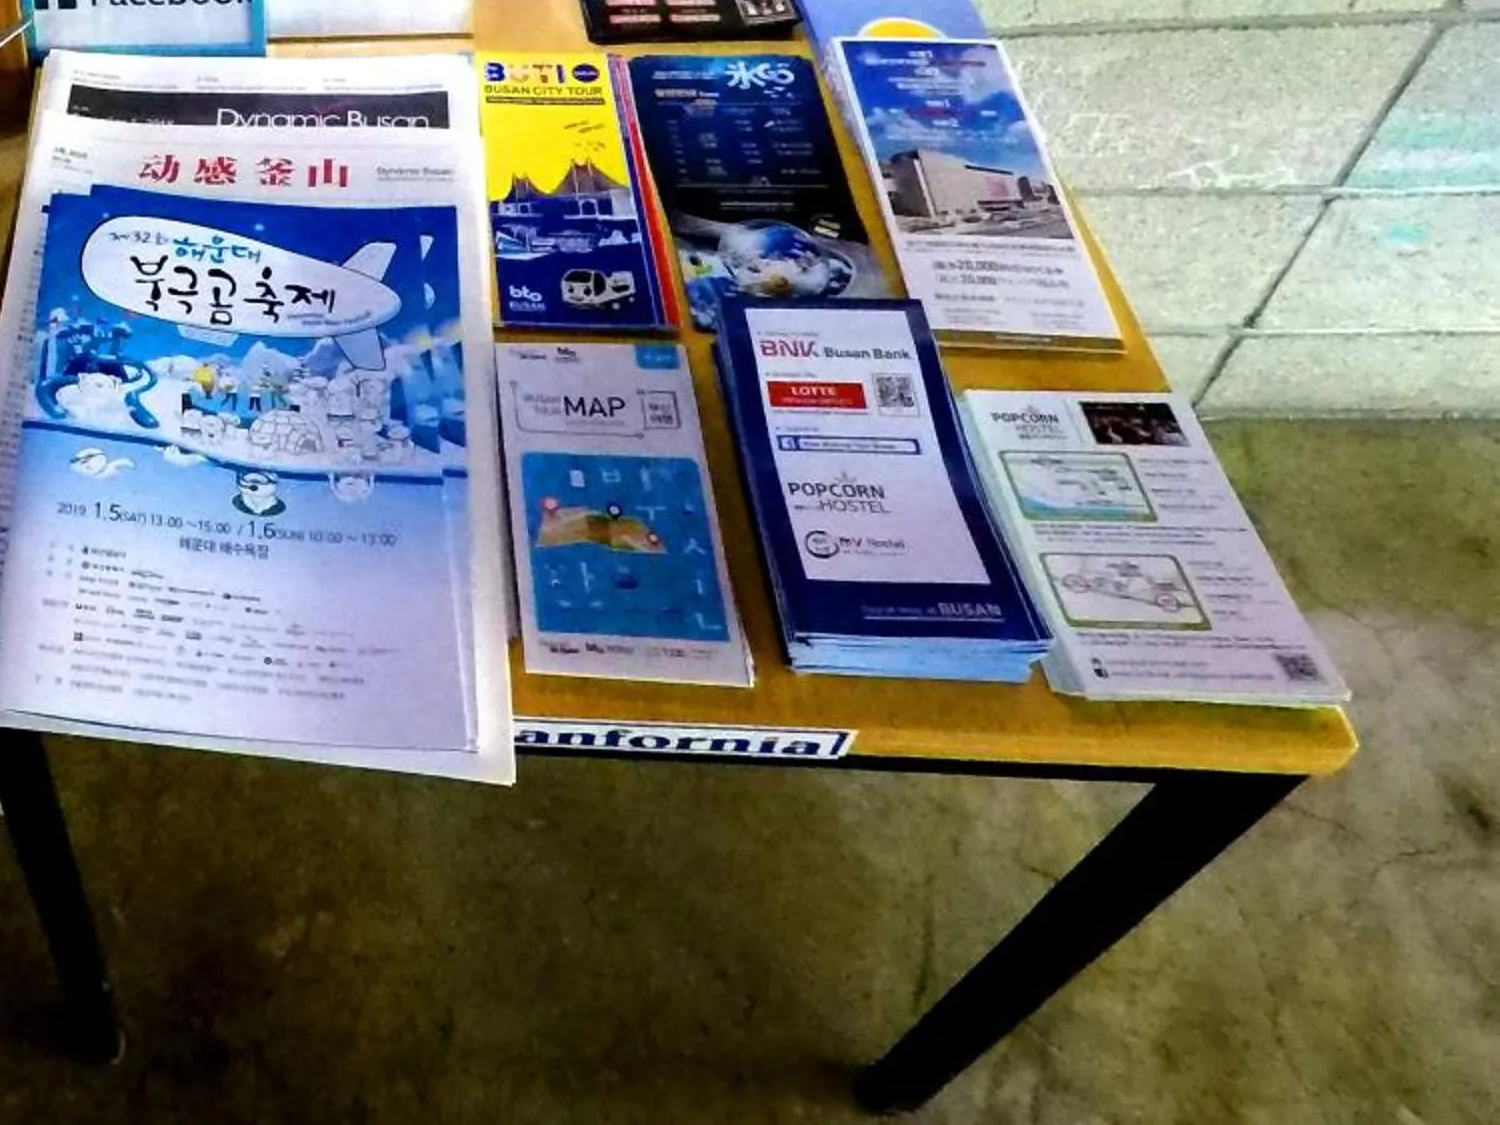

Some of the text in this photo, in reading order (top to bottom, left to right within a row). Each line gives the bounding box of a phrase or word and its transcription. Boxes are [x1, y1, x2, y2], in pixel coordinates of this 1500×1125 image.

[484, 84, 603, 95] BUSAN CITY TOUR
[173, 234, 261, 264] 해운대
[760, 339, 911, 360] BNK Busan Bank
[563, 395, 626, 417] MAP
[991, 412, 1059, 425] POPCORN
[788, 482, 885, 499] POPCORN
[819, 500, 892, 513] HOSTEL
